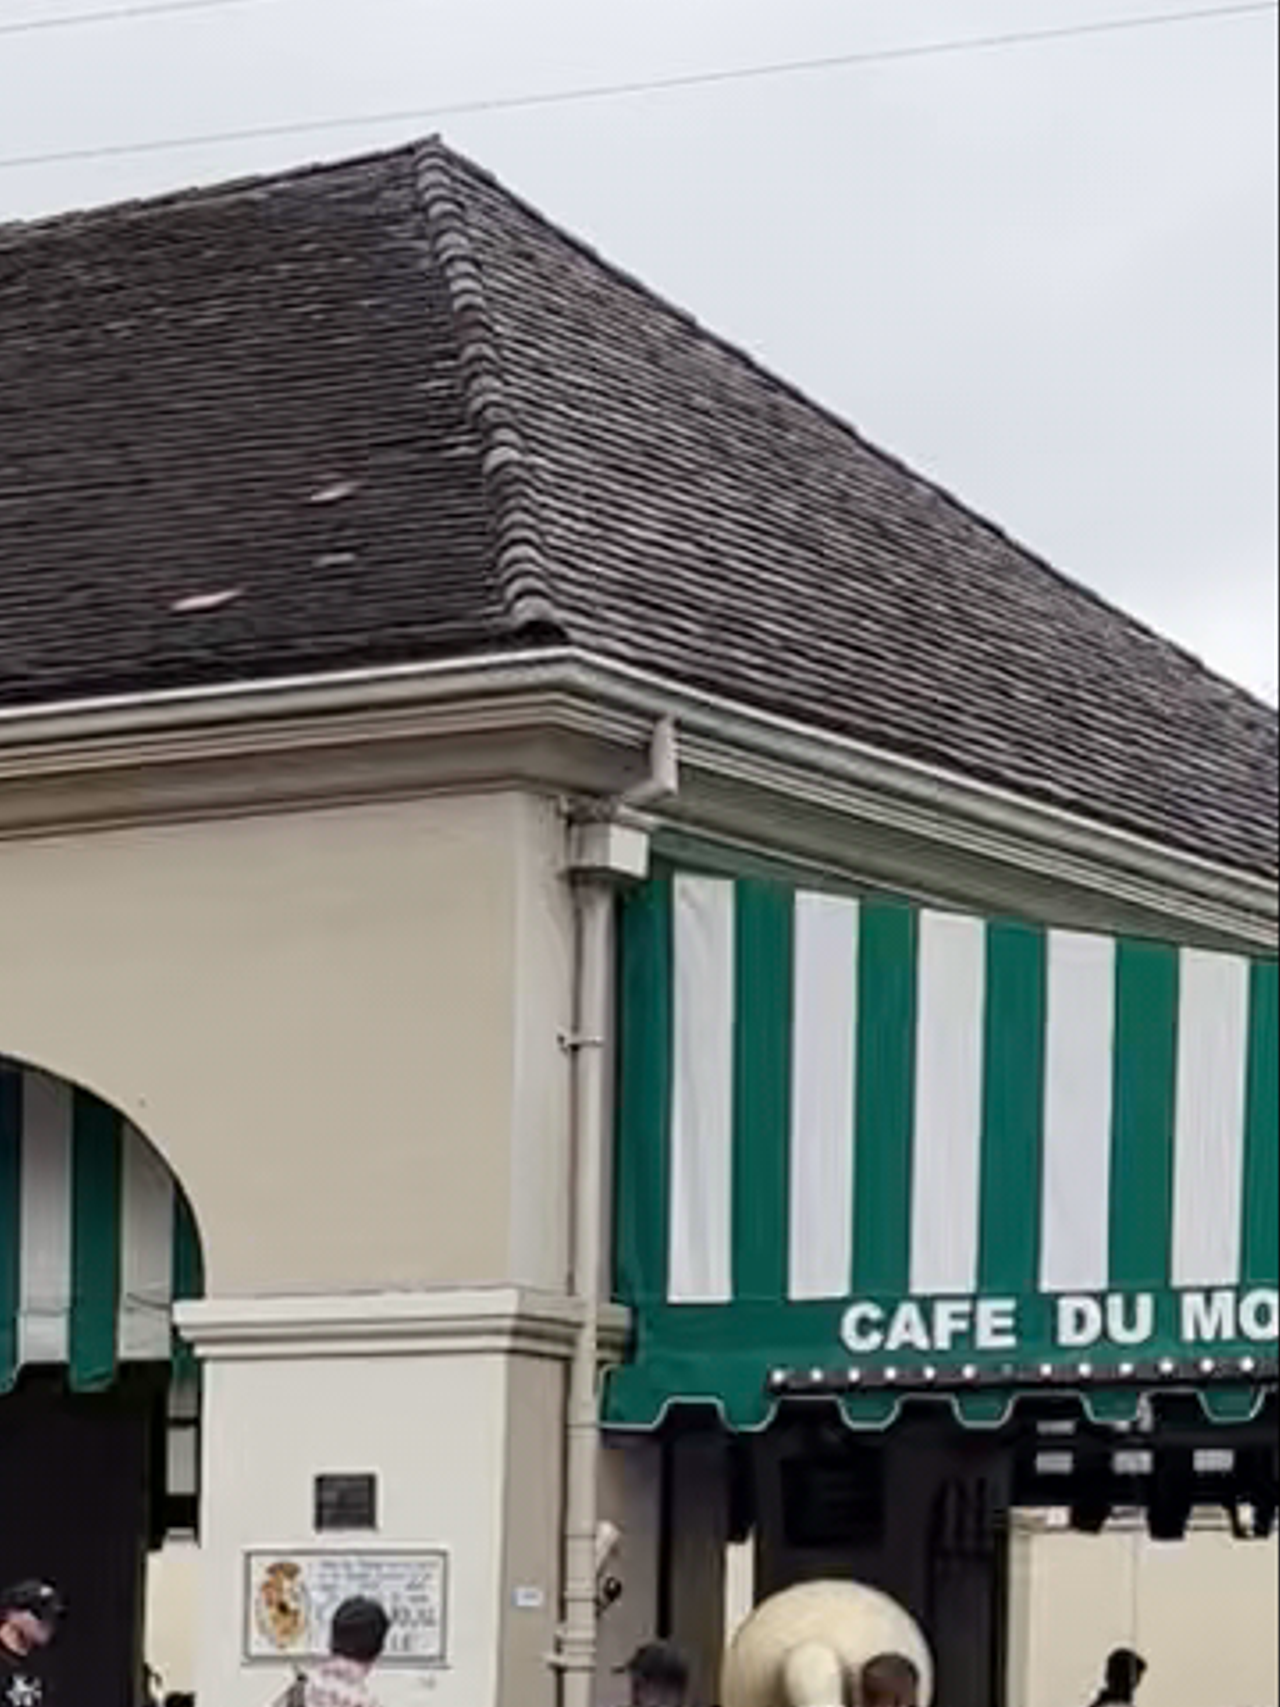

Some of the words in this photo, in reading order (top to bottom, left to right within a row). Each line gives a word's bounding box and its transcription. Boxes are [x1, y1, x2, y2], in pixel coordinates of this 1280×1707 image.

[841, 1298, 1017, 1351] CAFE
[1056, 1292, 1154, 1347] DU
[1180, 1288, 1278, 1342] MO
